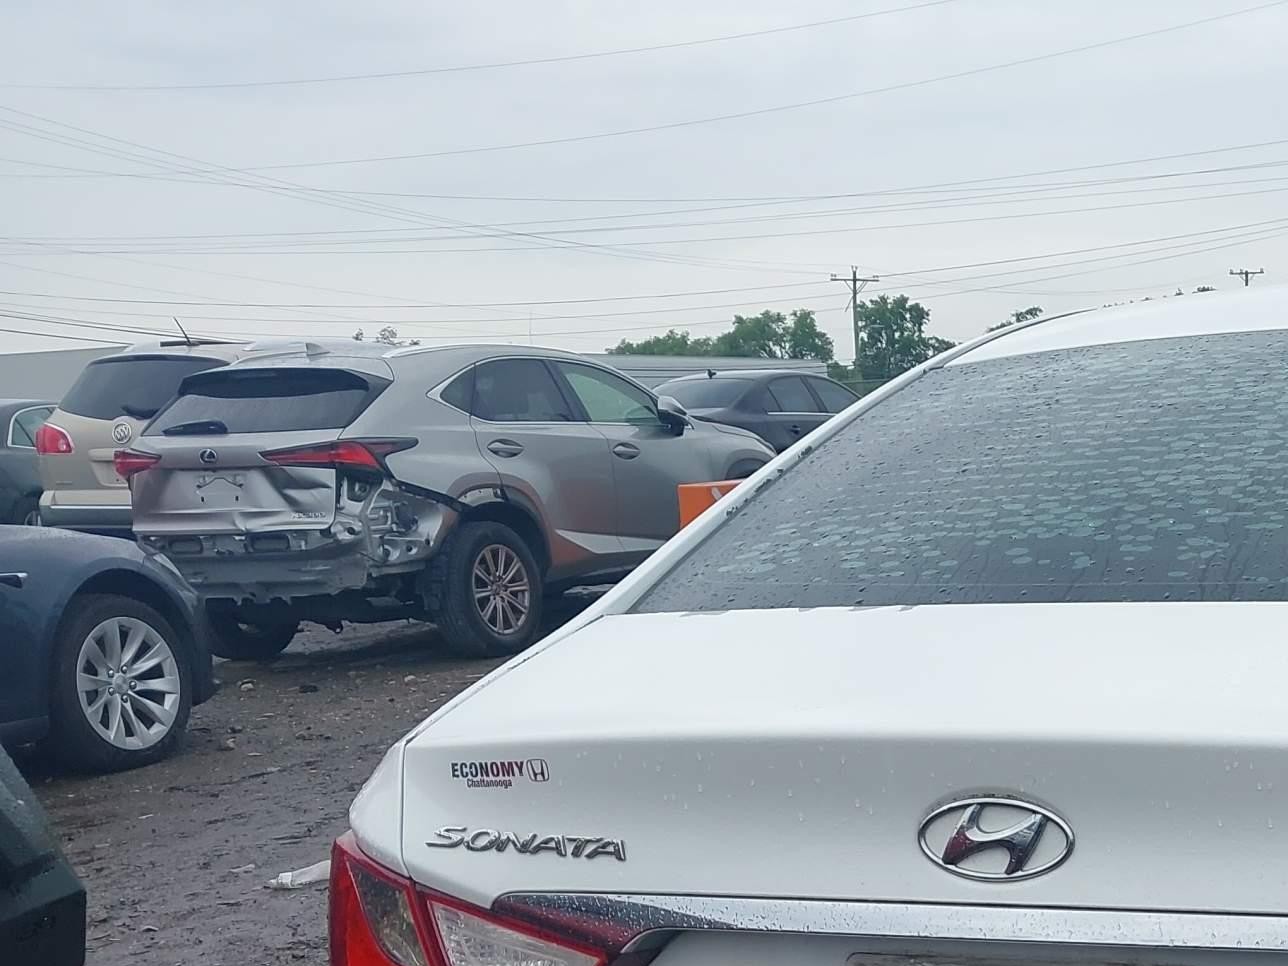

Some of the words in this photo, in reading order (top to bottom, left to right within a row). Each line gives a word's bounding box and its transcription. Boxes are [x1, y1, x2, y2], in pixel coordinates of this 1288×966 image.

[451, 761, 524, 778] ECONOMY
[466, 778, 513, 789] Chattanooga
[425, 826, 627, 862] SONATA
